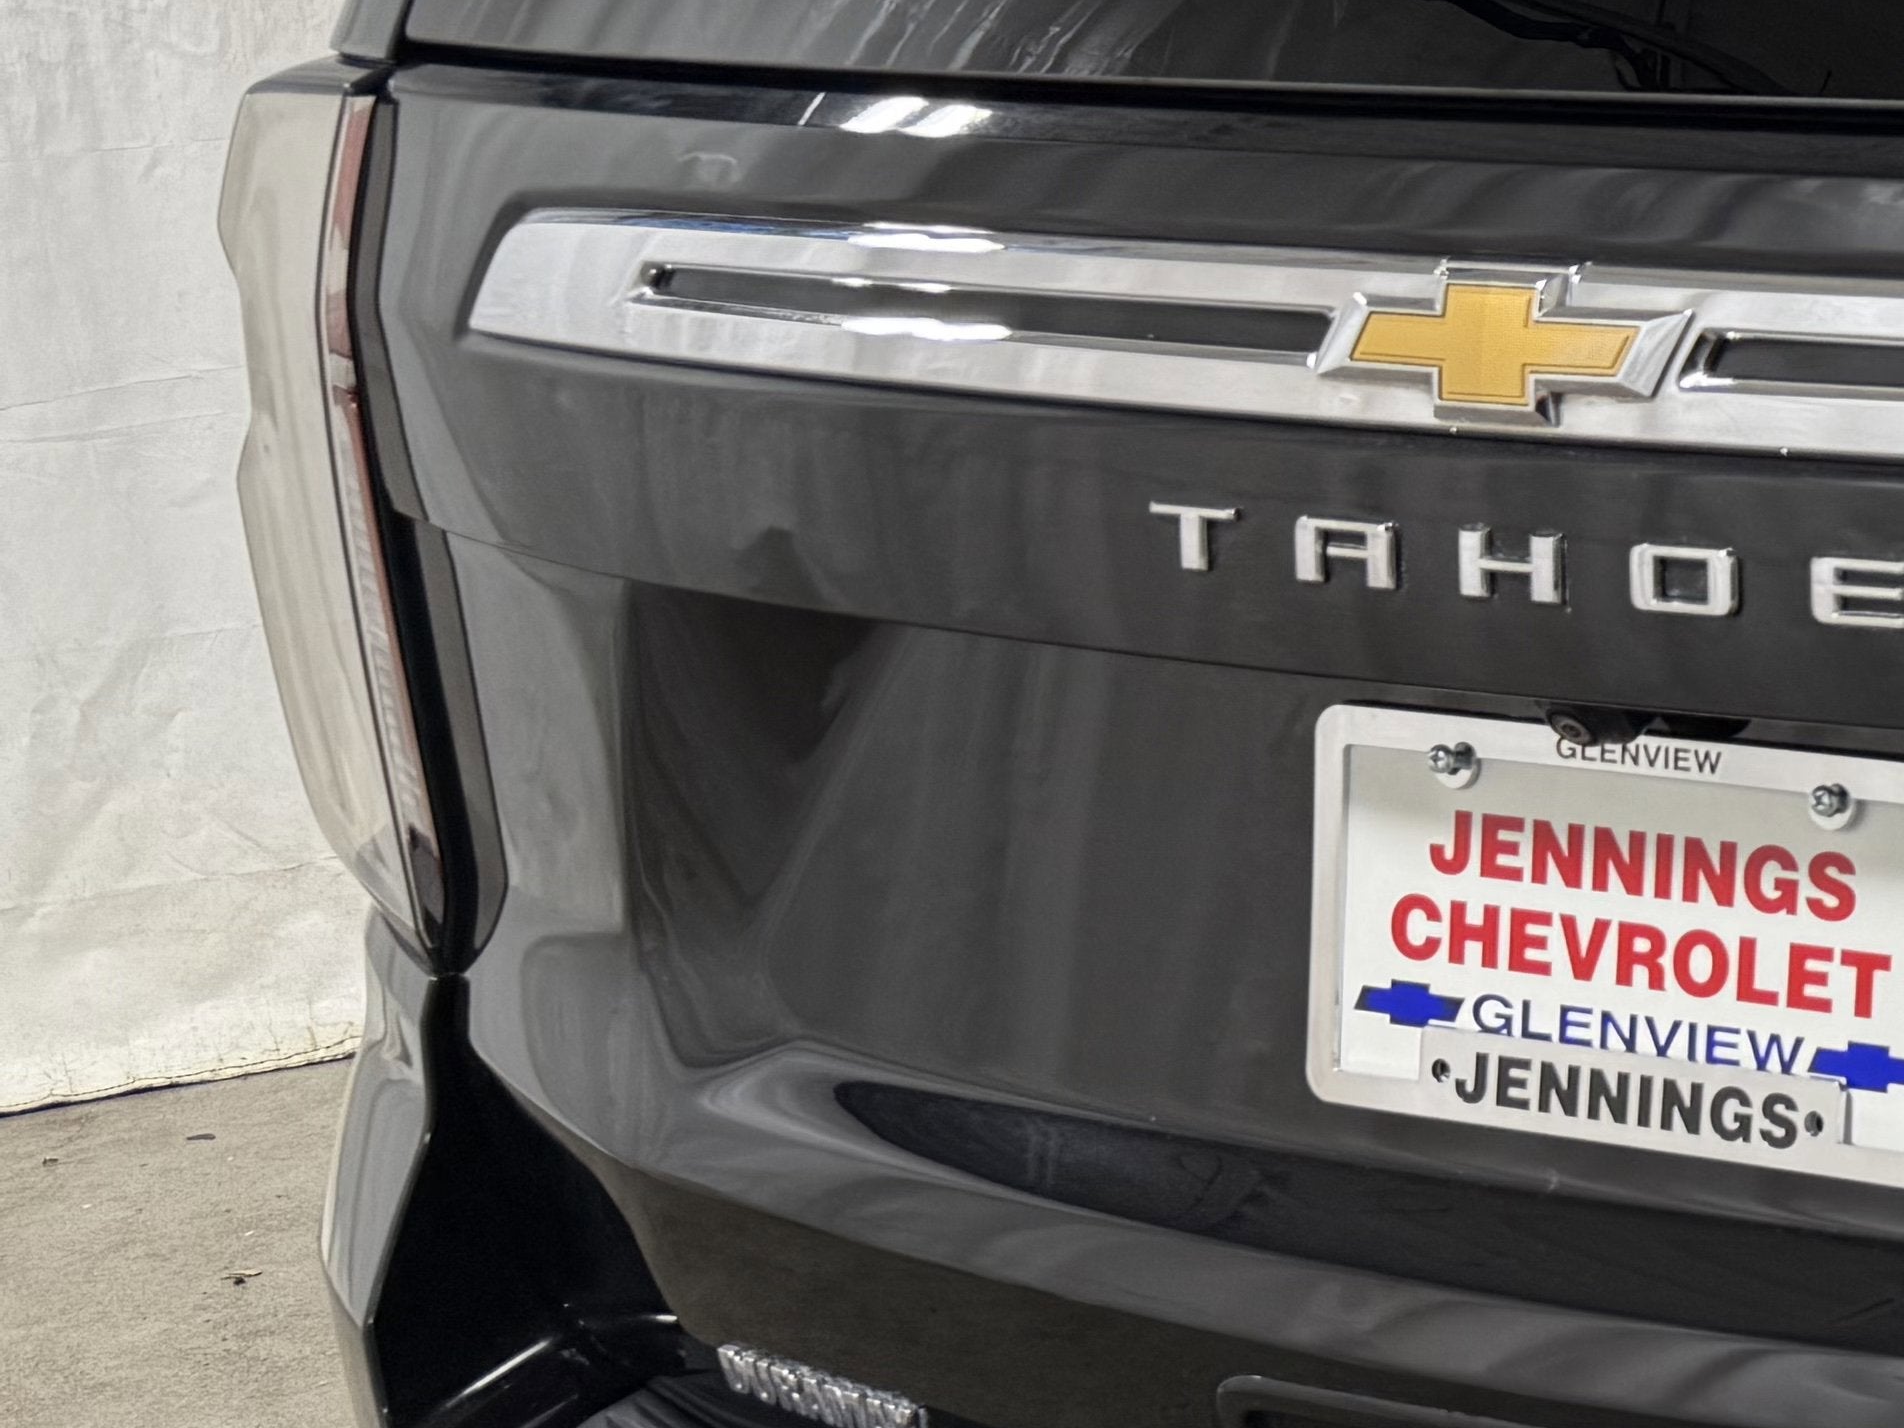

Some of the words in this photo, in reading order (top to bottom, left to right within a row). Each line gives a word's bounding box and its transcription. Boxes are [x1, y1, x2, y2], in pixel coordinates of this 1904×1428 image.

[1556, 737, 1723, 775] GLENVIEW
[1428, 809, 1857, 923] JENNINGS
[1389, 892, 1892, 1019] CHEVROLET
[1471, 993, 1805, 1074] GLENVIEW
[1454, 1051, 1798, 1150] JENNINGS
